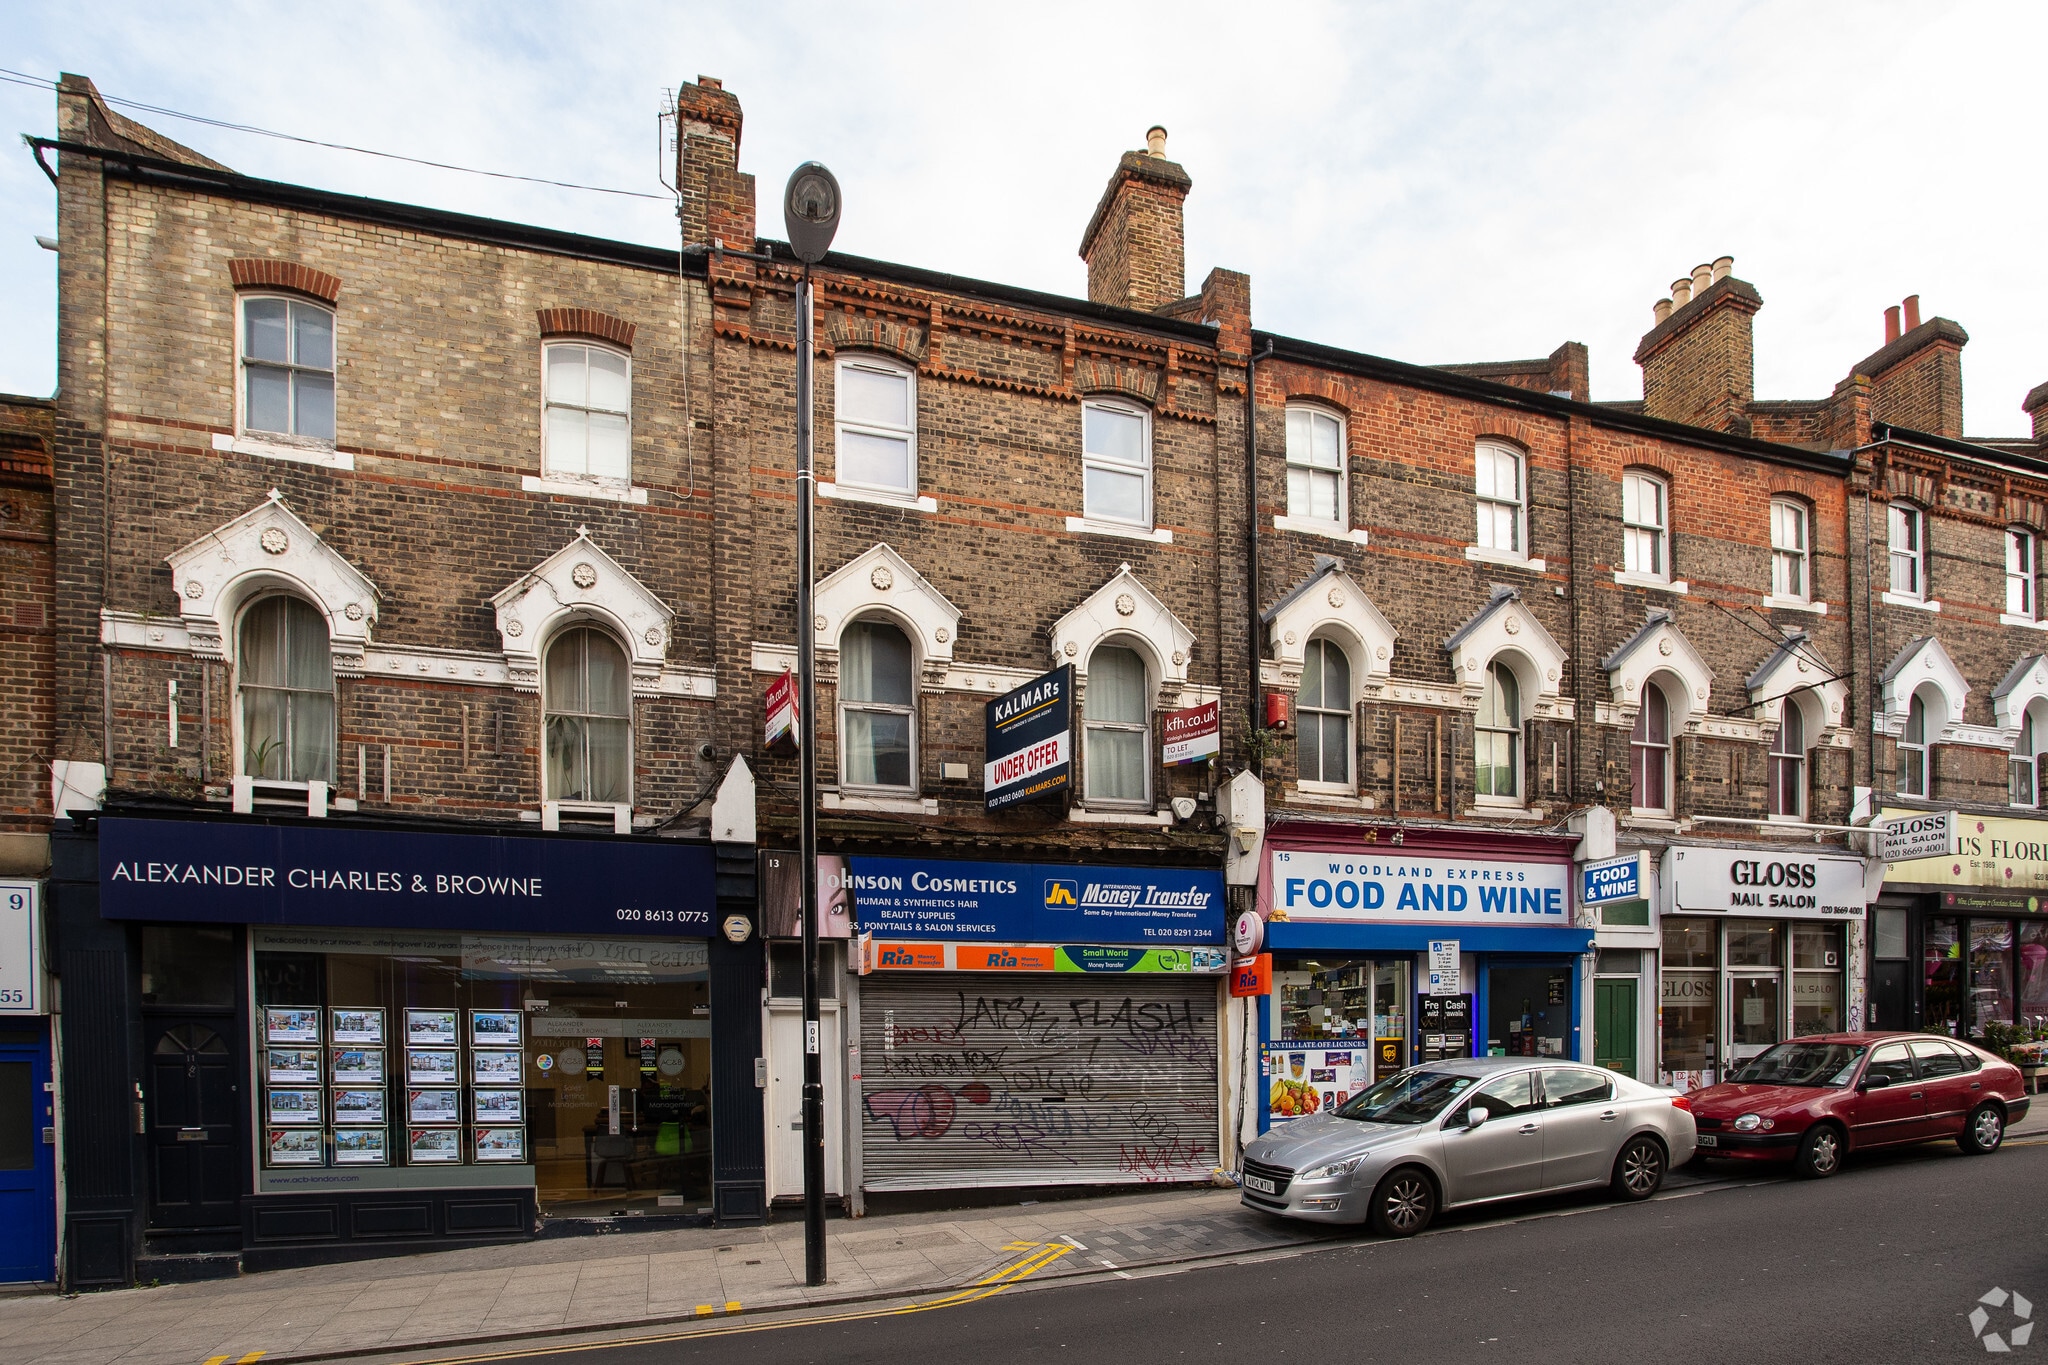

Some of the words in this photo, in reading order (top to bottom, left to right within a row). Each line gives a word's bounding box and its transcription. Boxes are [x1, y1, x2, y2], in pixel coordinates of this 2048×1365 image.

[1166, 708, 1216, 732] kfh.co.uk
[1177, 743, 1188, 752] LET
[994, 754, 1025, 785] UNDER
[1027, 740, 1059, 773] OFFER
[988, 797, 998, 808] 020
[999, 793, 1011, 804] 7403
[1012, 788, 1024, 800] 0600
[1025, 775, 1066, 796] KALMARS.COM
[1886, 815, 1946, 837] GLOSS
[1885, 838, 1907, 848] NAIL
[1911, 832, 1946, 844] SALON
[1278, 853, 1290, 862] 15
[1676, 852, 1684, 860] 17
[1885, 849, 1900, 859] 020
[1902, 846, 1923, 857] 8669
[1925, 843, 1945, 853] 4001
[769, 859, 780, 868] 13
[111, 861, 276, 888] ALEXANDER
[288, 868, 402, 892] CHARLES
[411, 874, 428, 893] &
[436, 874, 542, 897] BROWNE
[1329, 864, 1433, 878] WOODLAND
[1447, 869, 1525, 882] EXPRESS
[1592, 866, 1630, 884] FOOD
[1730, 859, 1816, 888] GLOSS
[1081, 883, 1140, 908] Money
[1144, 885, 1211, 906] Transfer
[1286, 878, 1385, 909] FOOD
[1397, 883, 1468, 912] AND
[1478, 885, 1562, 915] WINE
[1587, 887, 1597, 899] &
[1600, 880, 1636, 897] WINE
[9, 893, 23, 911] 9
[856, 897, 891, 906] HUMAN
[894, 898, 901, 906] &
[903, 899, 955, 908] SYNTHETICS
[957, 900, 979, 909] HAIR
[1731, 893, 1763, 907] NAIL
[1768, 894, 1816, 909] SALON
[616, 909, 641, 921] 020
[645, 910, 674, 923] 8613
[678, 911, 709, 923] 0775
[881, 911, 915, 919] BEAUTY
[917, 912, 956, 920] SUPPLIES
[1151, 911, 1170, 919] Money
[1821, 906, 1832, 914] 020
[1833, 906, 1848, 915] 8669
[1849, 907, 1862, 915] 4001
[864, 922, 913, 931] PONYTAILS
[915, 923, 922, 931] &
[924, 924, 954, 932] SALON
[956, 924, 996, 932] SERVICES
[1143, 928, 1156, 936] TEL
[1158, 929, 1172, 937] 020
[1174, 929, 1192, 937] 8291
[264, 935, 308, 945] Dedicated
[310, 936, 318, 945] to
[881, 946, 914, 966] Ria
[987, 949, 1017, 967] Ria
[1083, 949, 1105, 957] Small
[1106, 949, 1129, 957] World
[1173, 963, 1187, 971] LCC
[1240, 969, 1257, 988] Ria
[0, 989, 23, 1003] 55
[1661, 980, 1713, 997] GLOSS
[1424, 1000, 1439, 1010] Fre
[1445, 1000, 1466, 1010] Cash
[649, 1101, 697, 1109] Management
